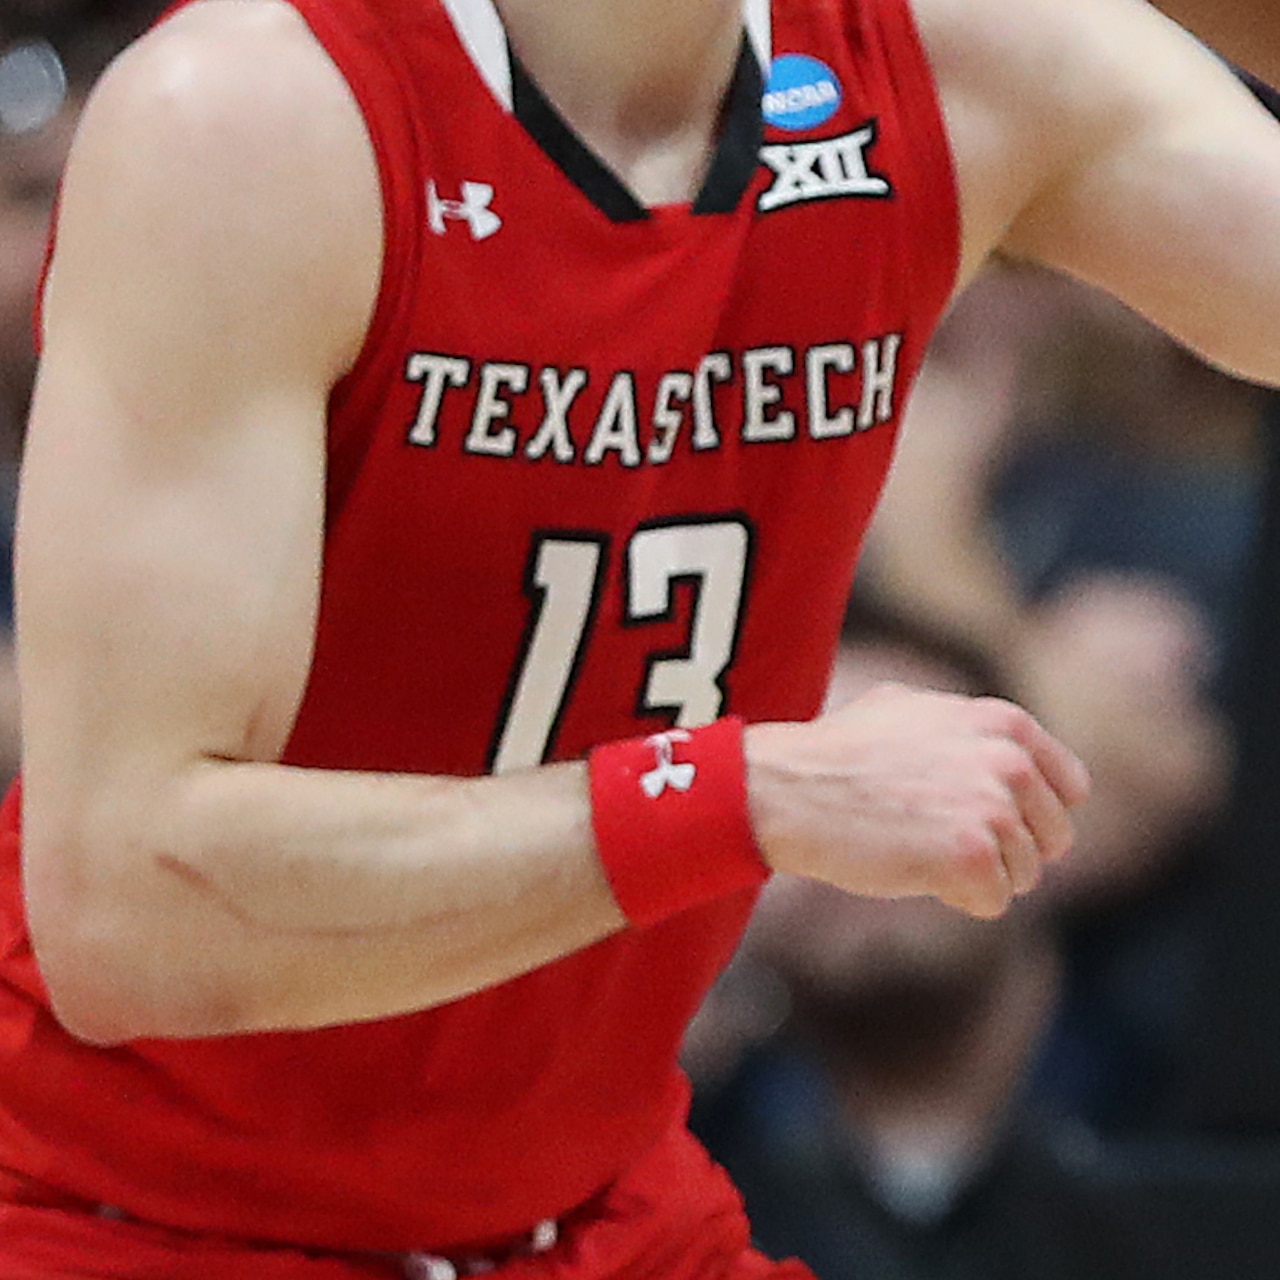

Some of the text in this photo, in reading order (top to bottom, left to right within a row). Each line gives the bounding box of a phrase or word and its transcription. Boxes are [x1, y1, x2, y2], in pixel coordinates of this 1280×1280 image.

[761, 79, 839, 115] NCAA
[757, 120, 893, 211] XII
[403, 333, 902, 472] TEXAS TECH
[486, 511, 755, 775] 13
